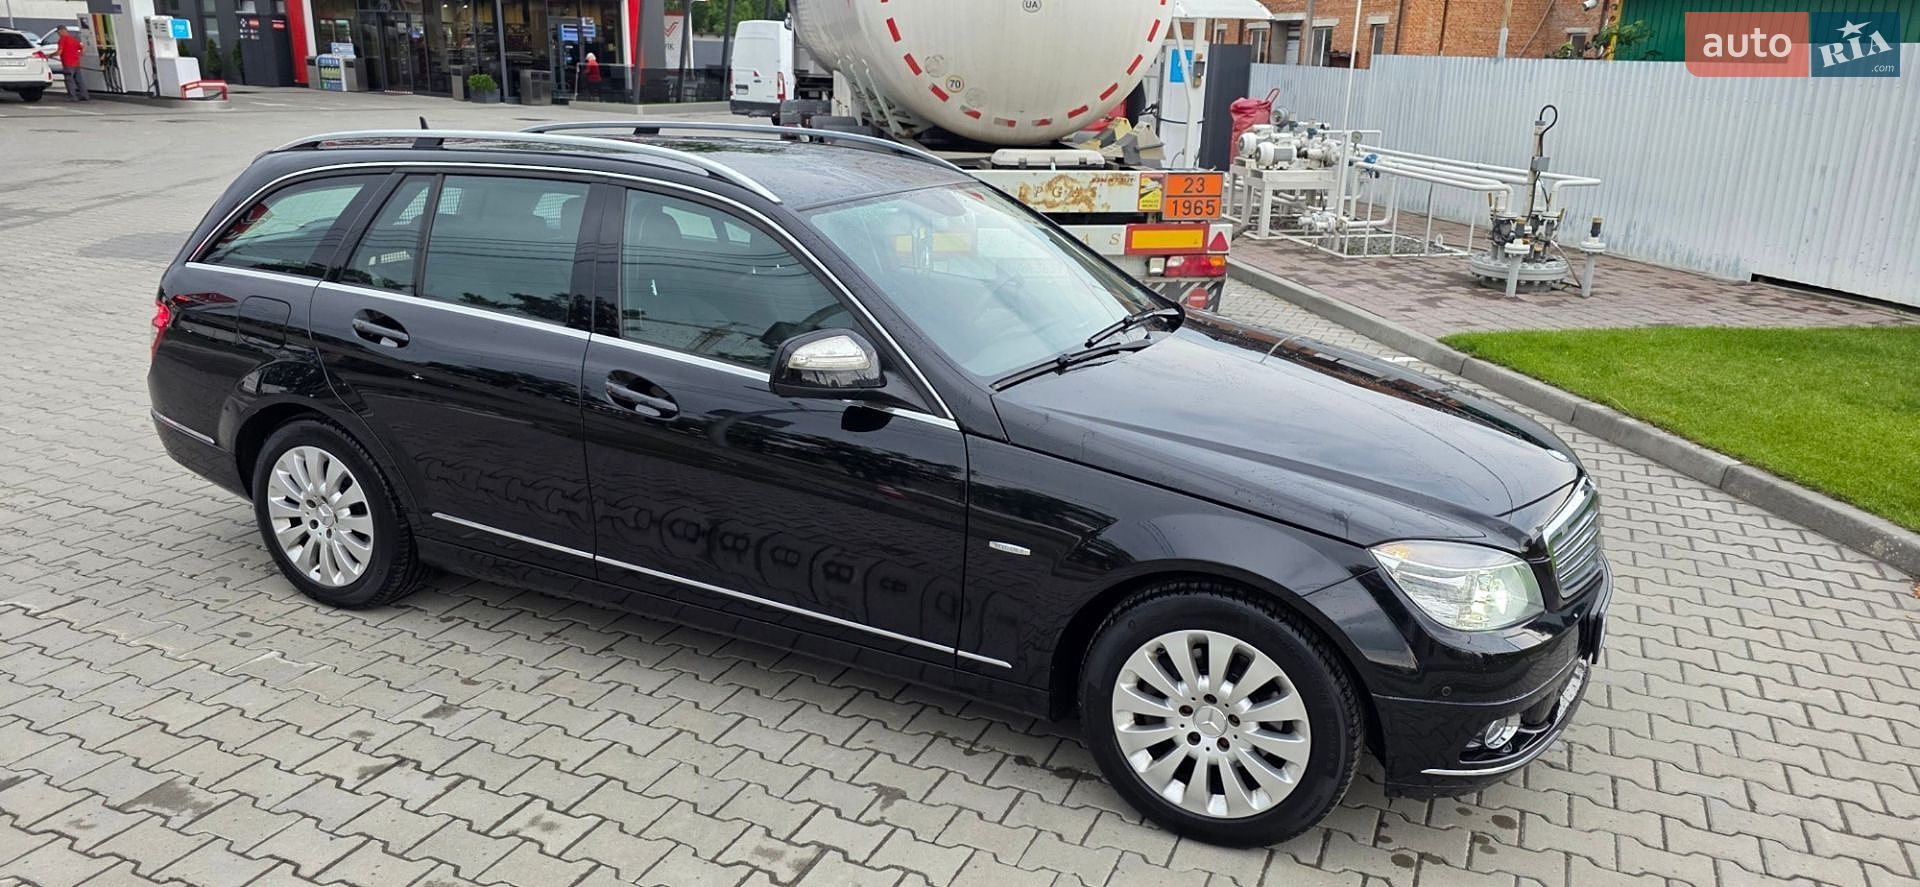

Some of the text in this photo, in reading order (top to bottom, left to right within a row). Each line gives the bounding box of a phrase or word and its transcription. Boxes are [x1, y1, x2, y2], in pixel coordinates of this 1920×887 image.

[1025, 0, 1038, 9] UA
[949, 79, 961, 89] 70
[1183, 177, 1206, 193] 23
[1172, 199, 1216, 216] 1965
